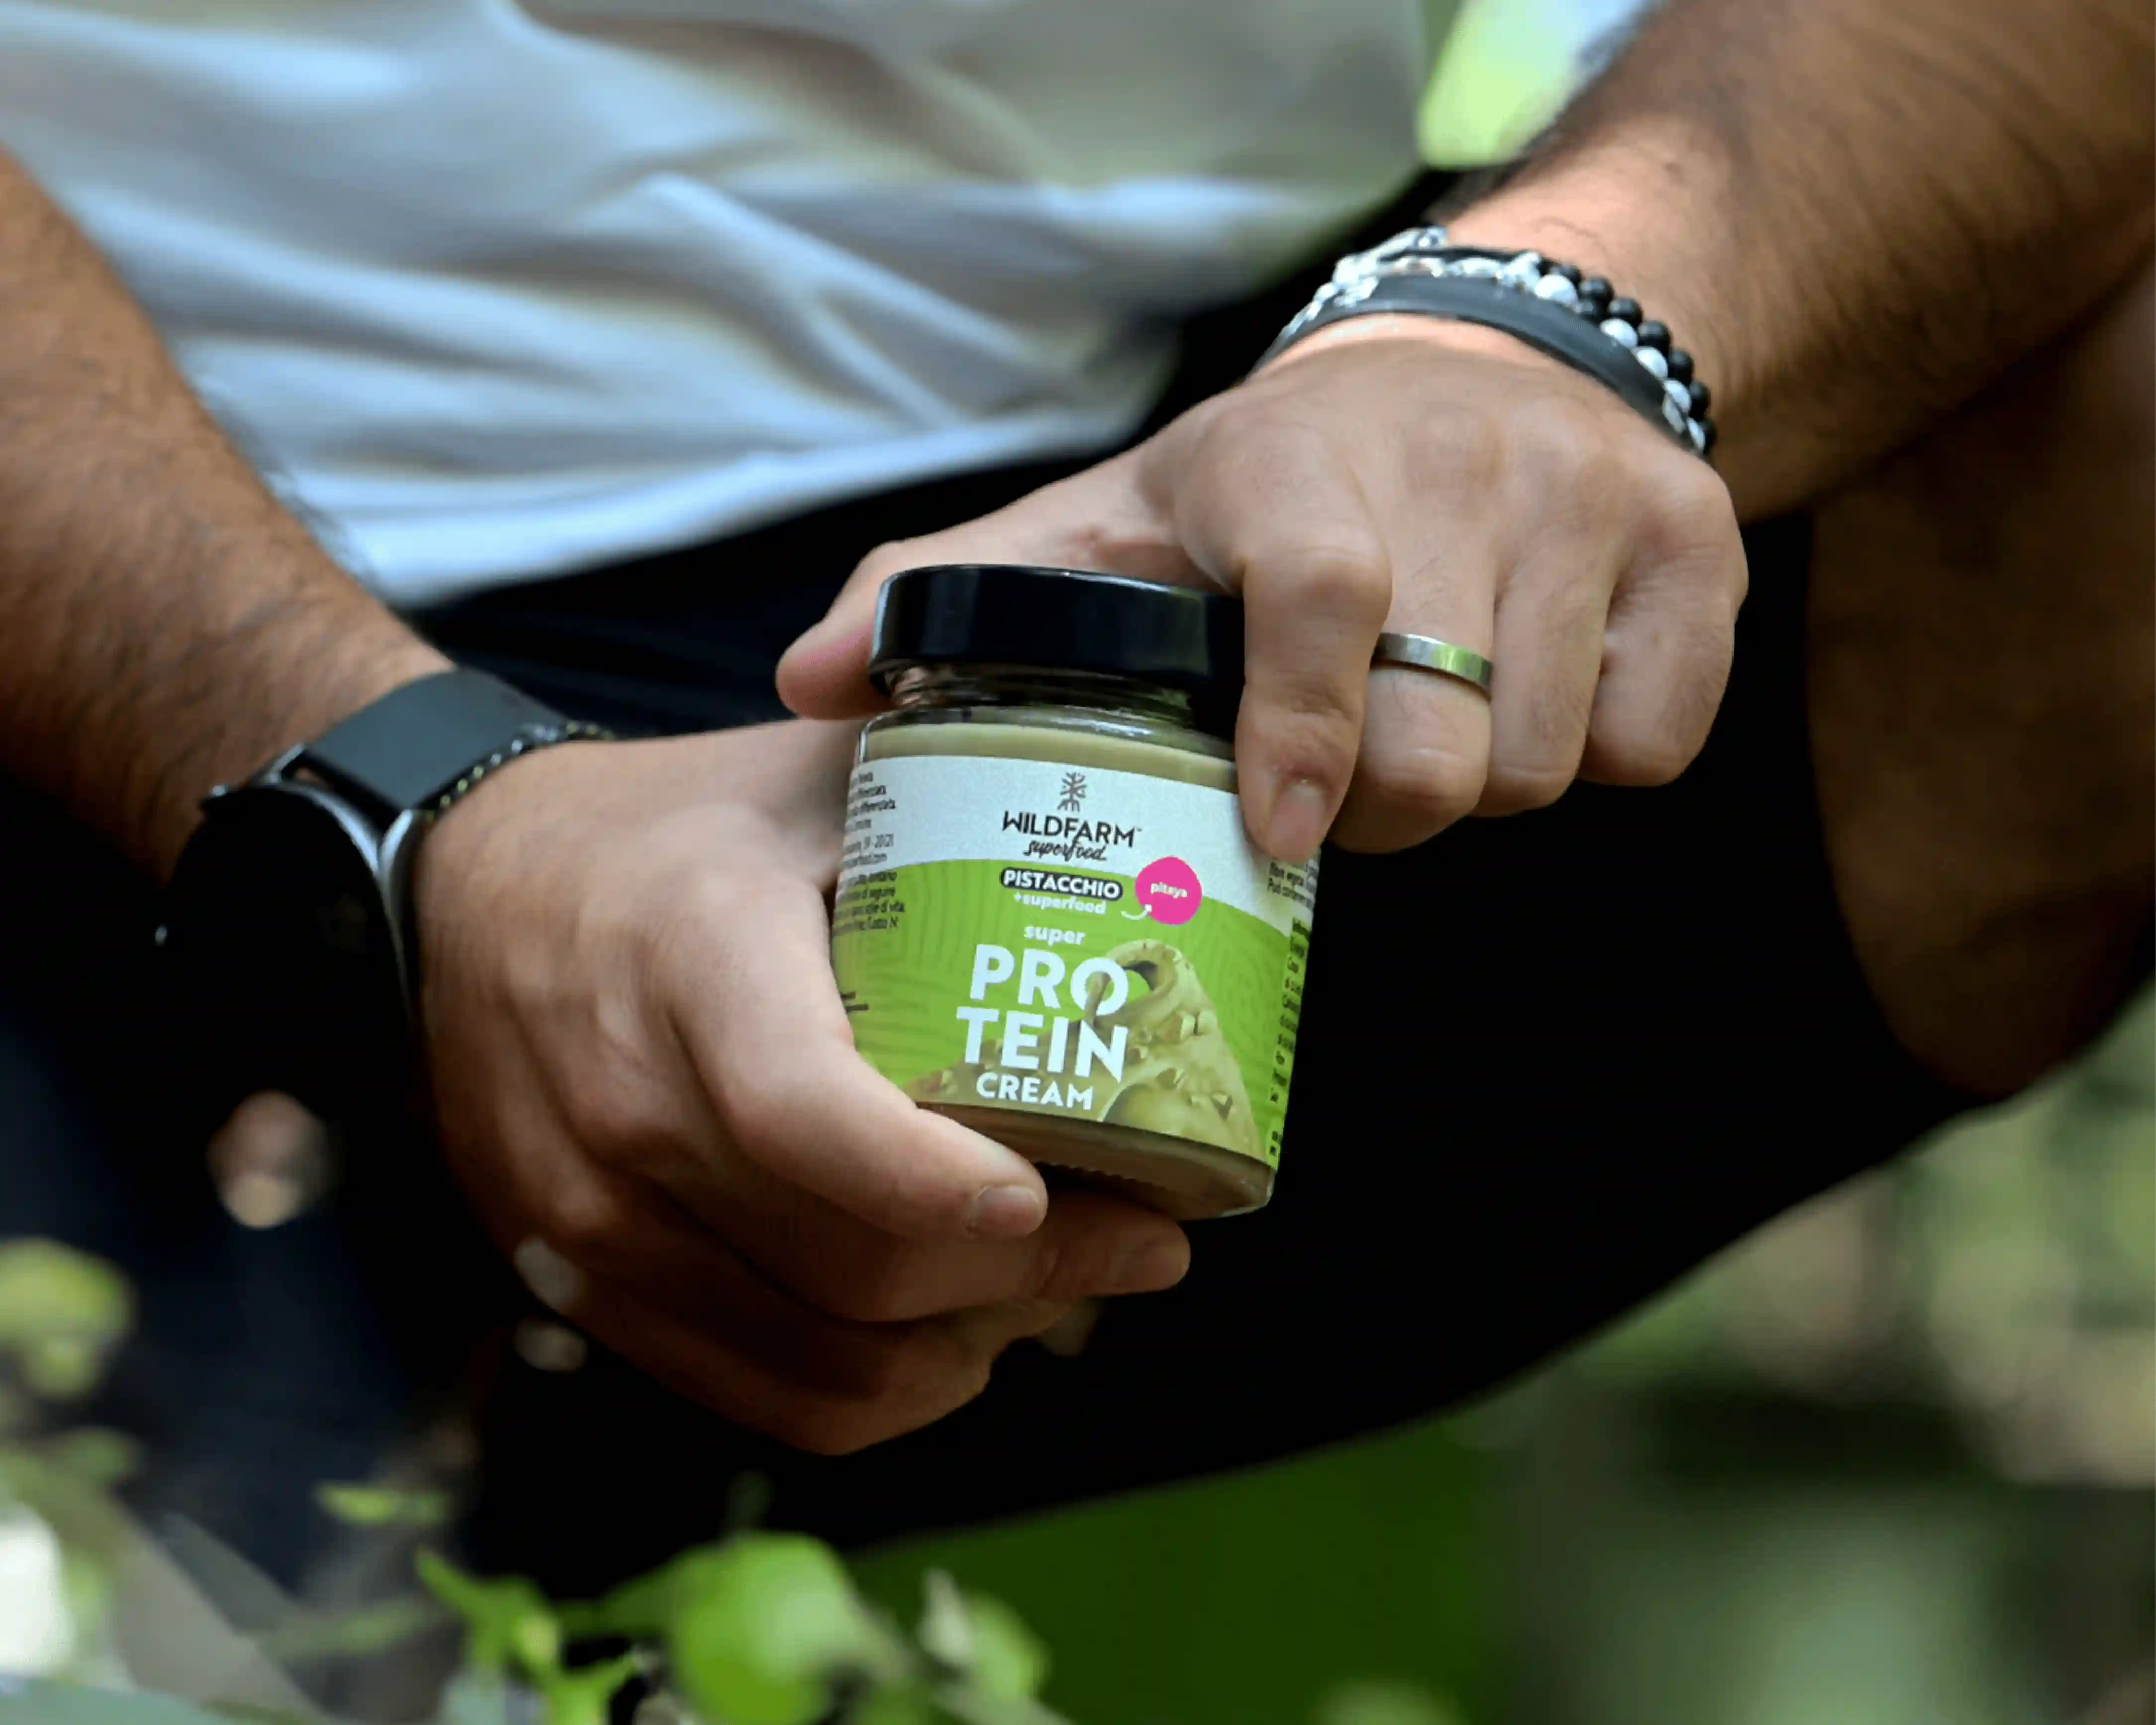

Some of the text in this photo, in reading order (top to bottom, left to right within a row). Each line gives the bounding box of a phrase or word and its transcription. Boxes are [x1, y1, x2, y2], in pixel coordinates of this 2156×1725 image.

[1002, 811, 1135, 847] WILDFARM
[1023, 837, 1107, 861] superfood
[1003, 869, 1120, 899] PISTACCHIO
[1024, 924, 1085, 946] super
[970, 944, 1129, 1016] PRO
[956, 1006, 1129, 1083] TEIN
[976, 1072, 1093, 1111] CREAM
